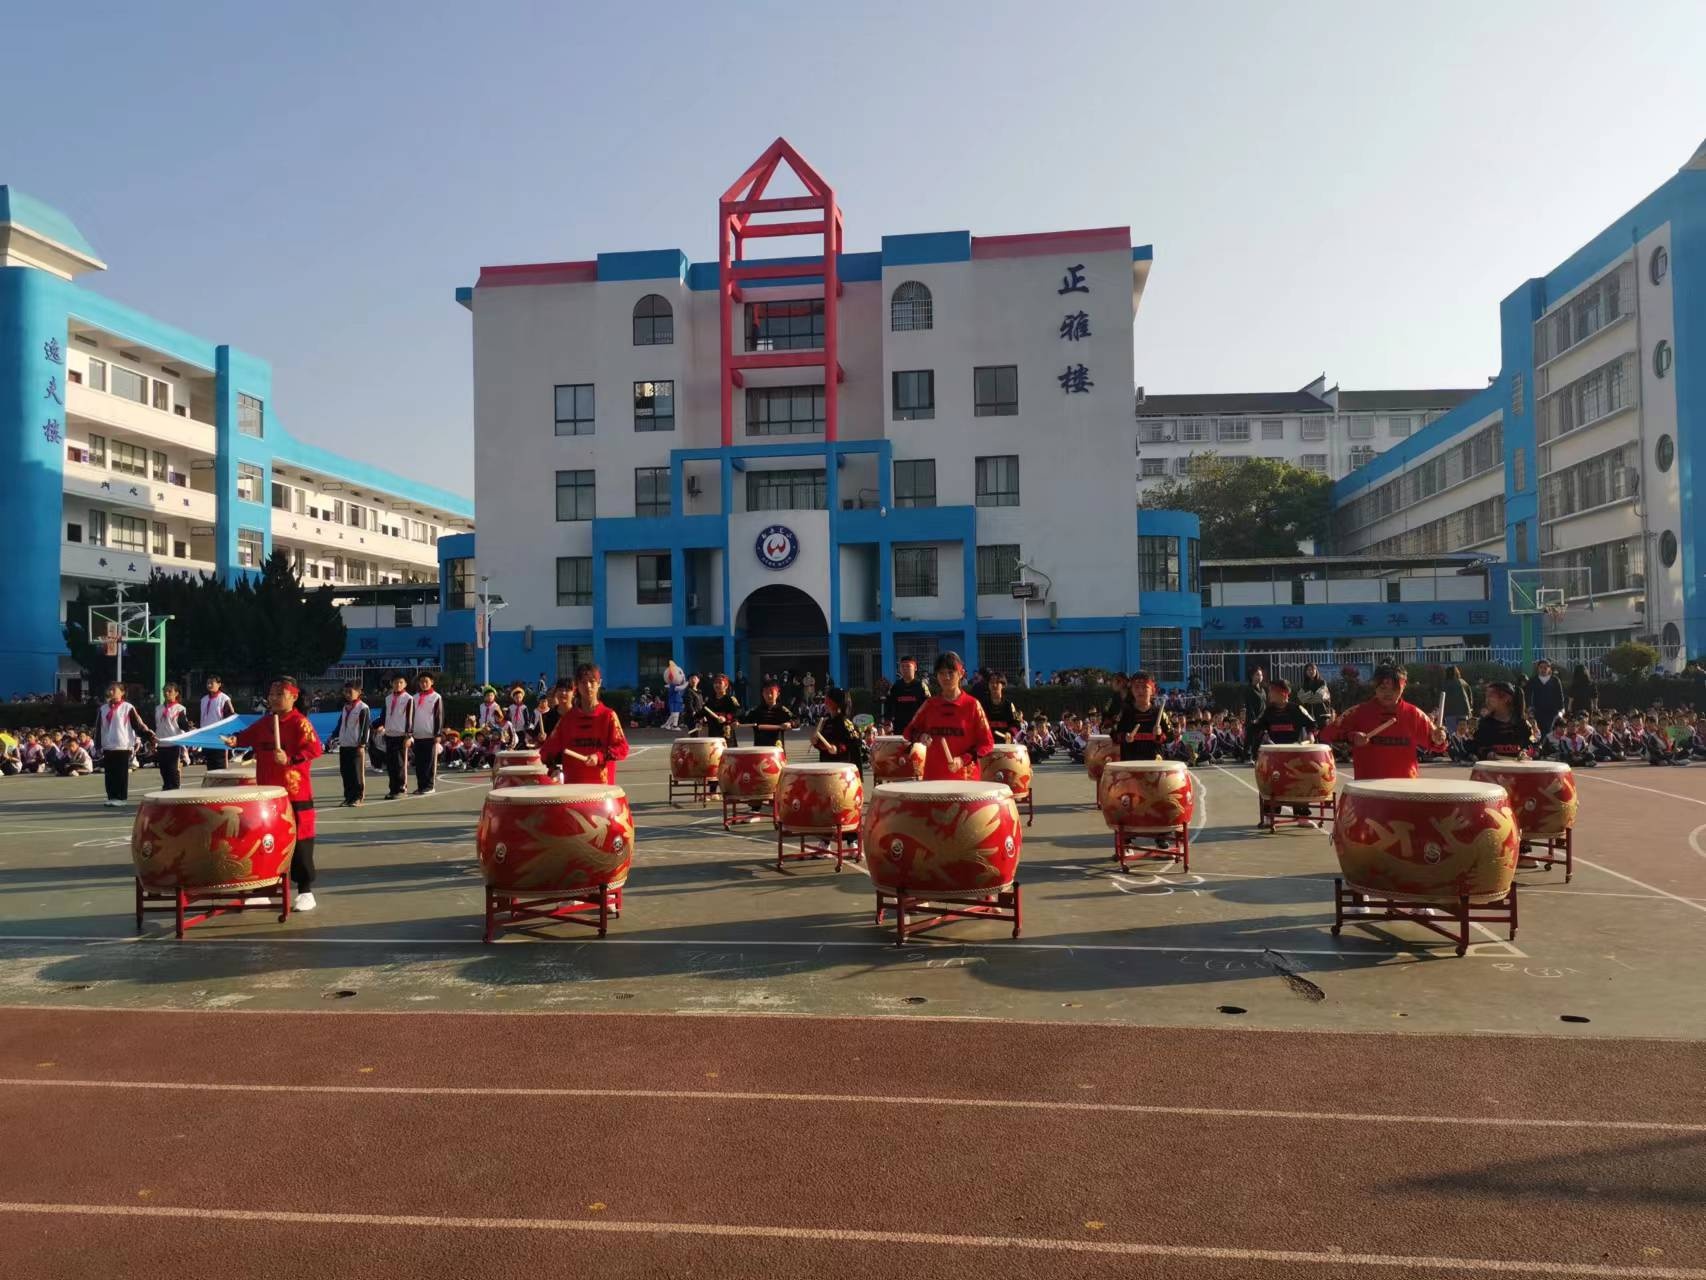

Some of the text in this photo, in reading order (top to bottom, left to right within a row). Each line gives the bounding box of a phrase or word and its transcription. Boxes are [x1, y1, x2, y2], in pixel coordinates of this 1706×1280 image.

[1057, 263, 1094, 395] 正雅楼
[42, 337, 65, 445] 逸夫楼
